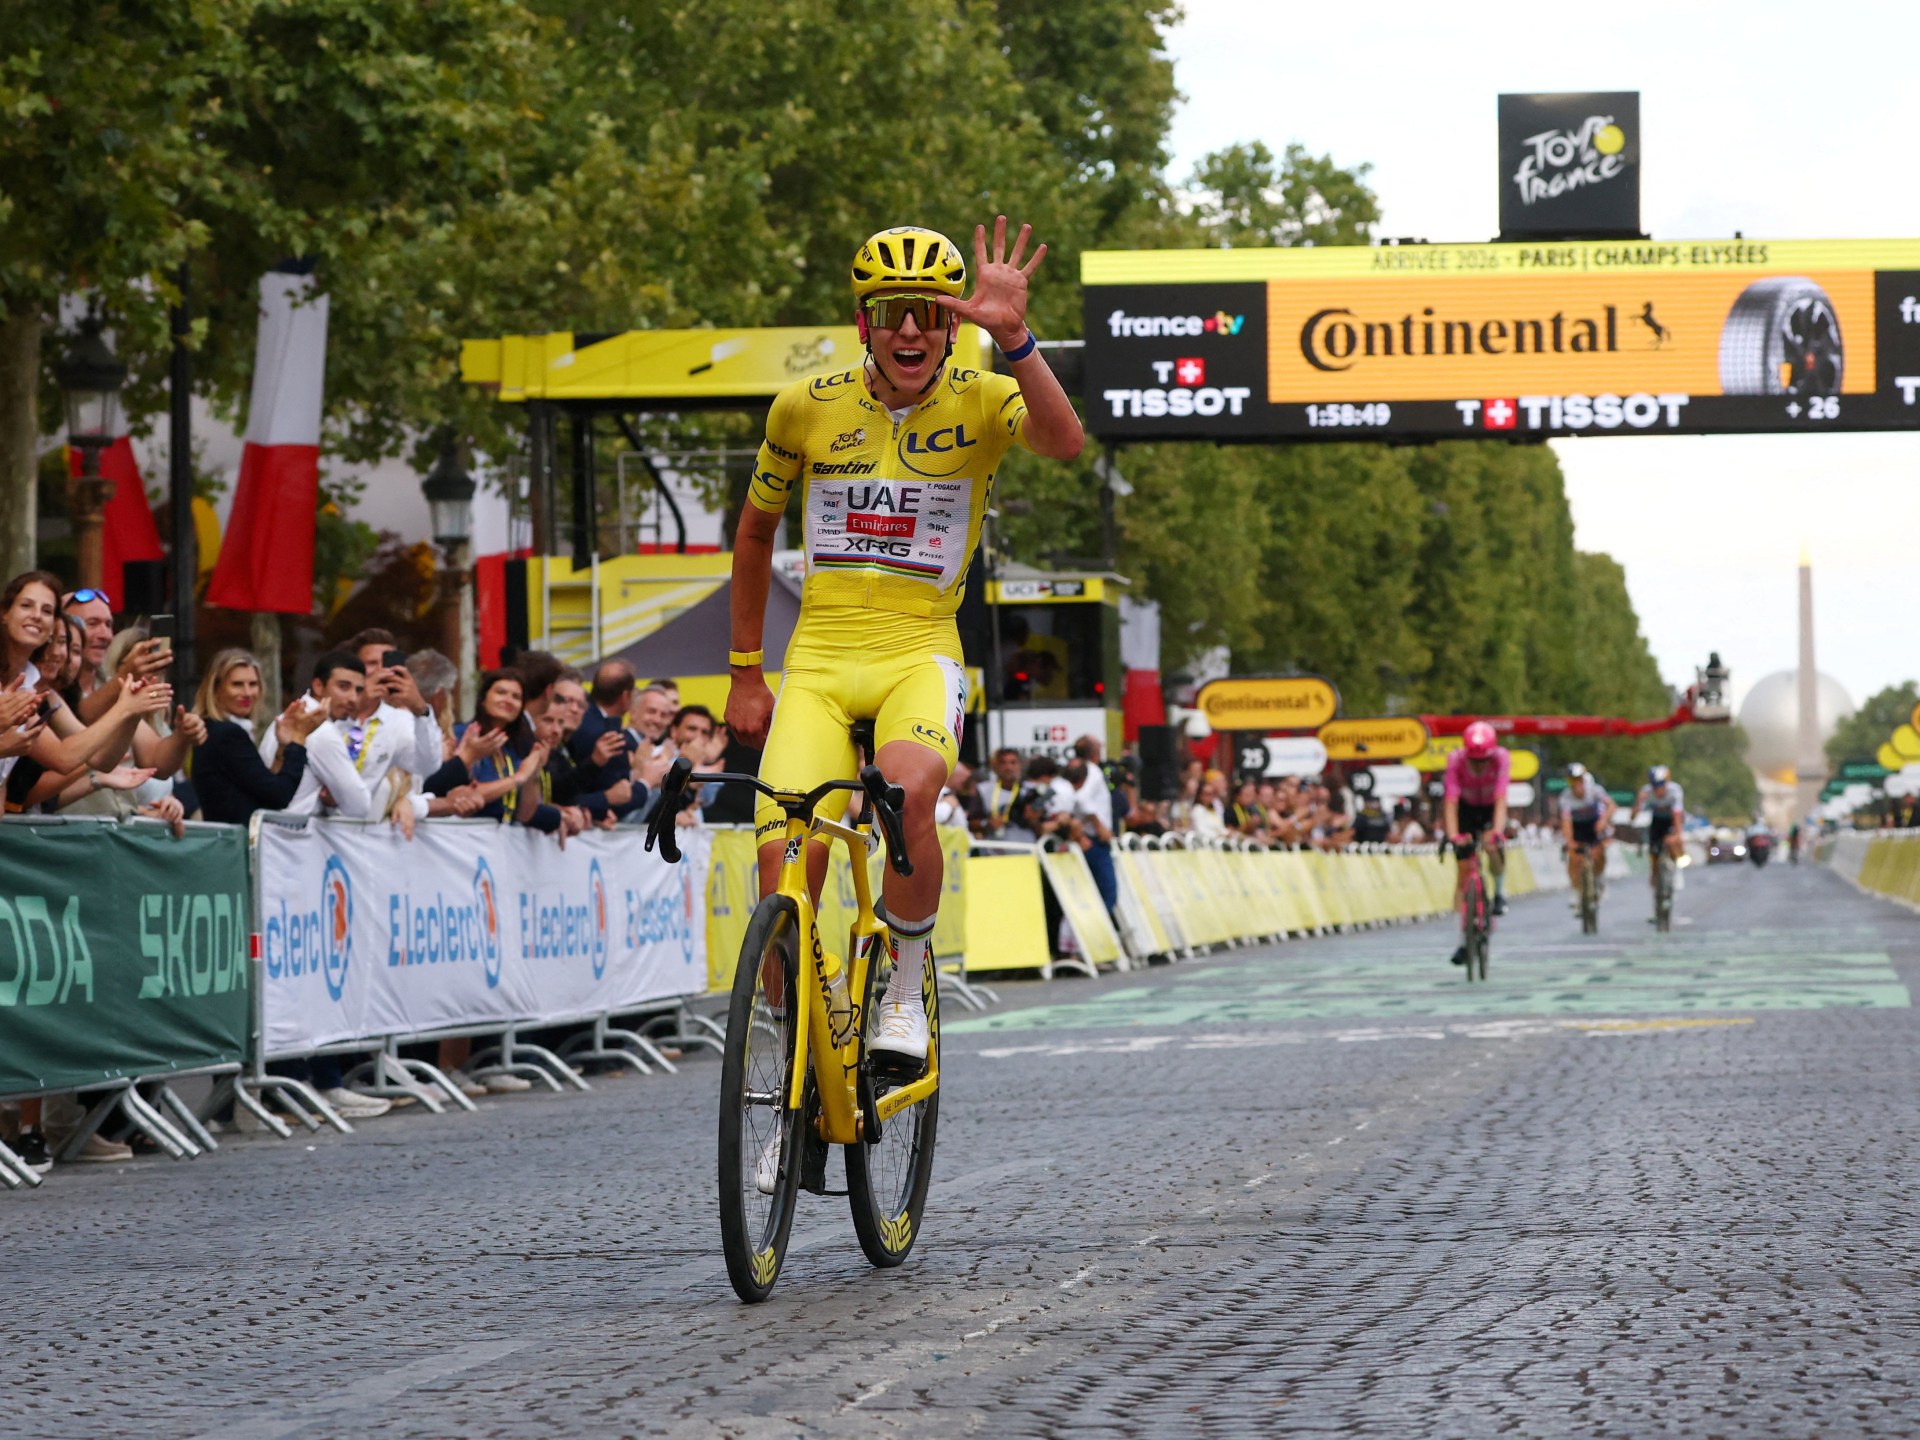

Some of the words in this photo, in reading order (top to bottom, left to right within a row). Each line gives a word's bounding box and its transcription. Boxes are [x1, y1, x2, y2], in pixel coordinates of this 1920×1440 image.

[1519, 249, 1577, 267] PARIS
[1300, 305, 1617, 372] Continental
[814, 371, 855, 389] LCL
[952, 367, 981, 382] LCL
[858, 398, 876, 412] LCL
[1103, 387, 1250, 417] TISSOT
[1517, 392, 1690, 429] TISSOT
[1808, 395, 1840, 419] 26
[766, 440, 798, 459] ntini
[907, 424, 977, 453] LCL
[812, 461, 878, 474] Santini
[848, 486, 922, 513] UAE
[852, 518, 908, 532] Emirates
[935, 524, 949, 533] IHC
[844, 538, 911, 557] XRG
[1206, 691, 1310, 714] Continental
[916, 725, 948, 749] LCL
[388, 892, 478, 967] E.Leclerc
[519, 893, 589, 959] E.Leclerc
[0, 895, 93, 1006] ODA
[266, 898, 319, 980] clerc
[810, 922, 838, 1050] COLNAGO
